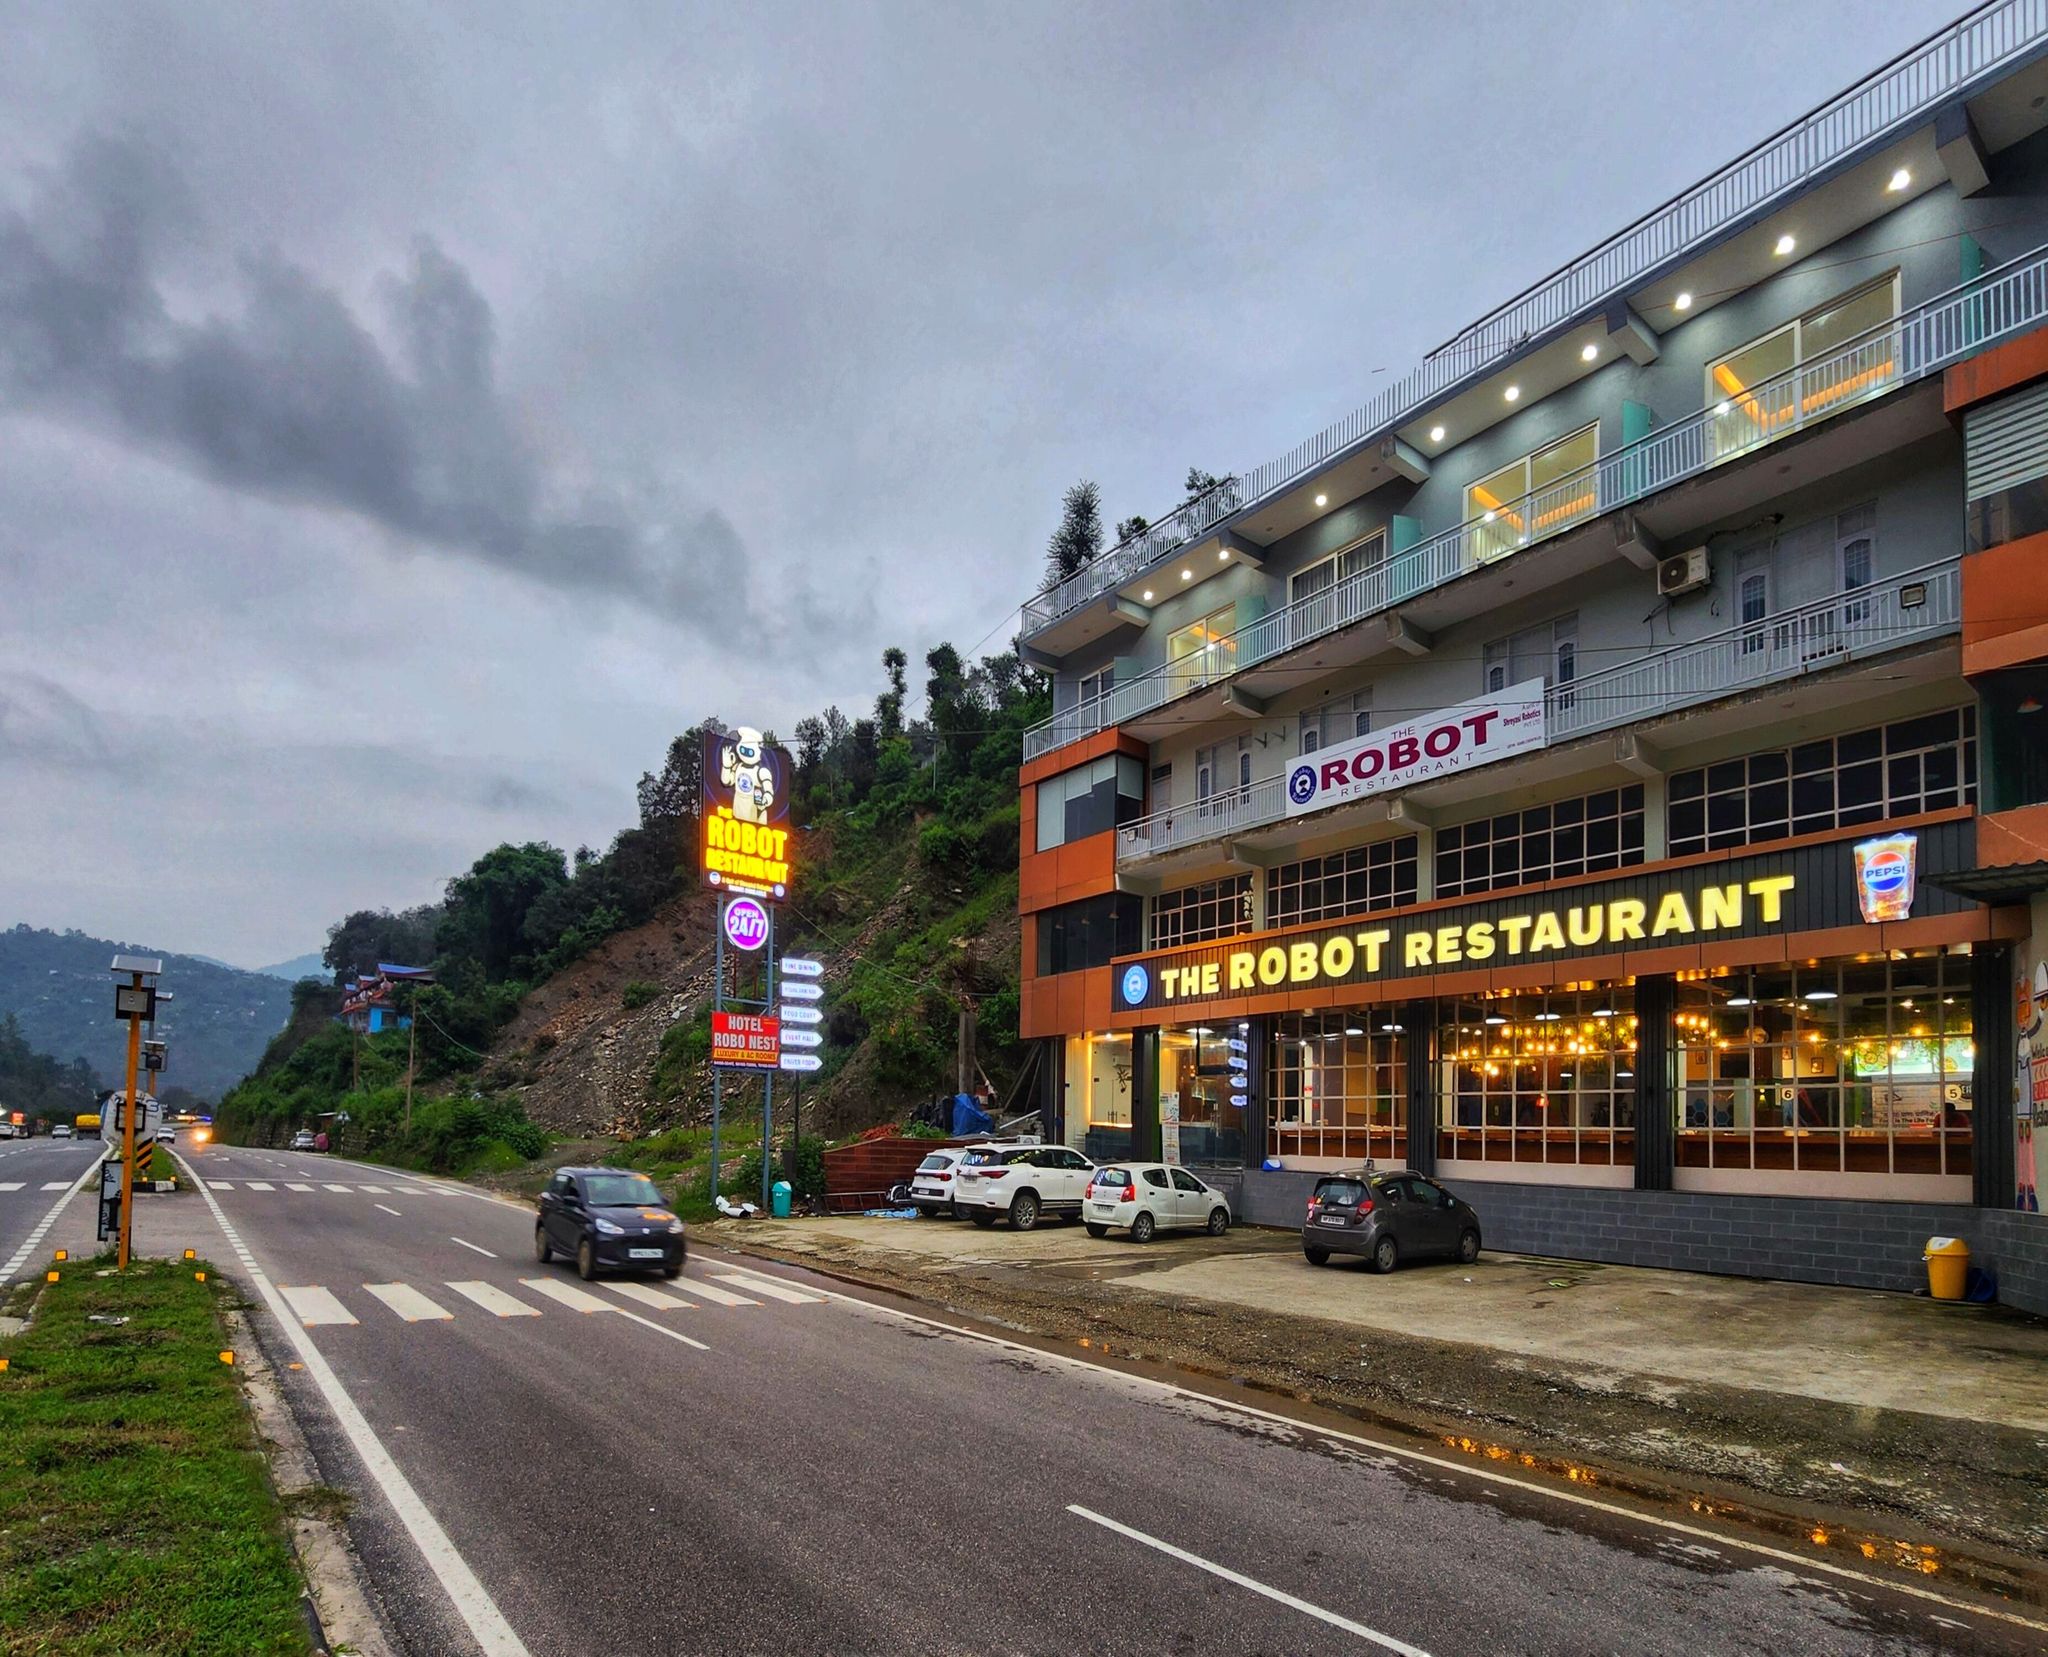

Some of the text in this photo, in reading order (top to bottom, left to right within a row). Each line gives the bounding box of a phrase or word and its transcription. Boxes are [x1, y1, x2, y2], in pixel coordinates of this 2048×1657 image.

[1391, 725, 1416, 740] THE
[1320, 710, 1499, 791] ROBOT
[1340, 751, 1475, 797] RESTAURANT
[707, 814, 788, 861] ROBOT
[705, 847, 789, 884] RESTAURANT
[1866, 866, 1906, 878] PEPSI
[733, 906, 759, 919] OPEN
[730, 915, 765, 938] 24/7
[1160, 875, 1796, 999] THE ROBOT RESTAURANT
[728, 1015, 764, 1032] HOTEL
[714, 1032, 777, 1051] ROBO NEST
[716, 1049, 740, 1058] LUXURY
[746, 1051, 754, 1059] AC
[755, 1051, 776, 1060] ROOMS
[1784, 1089, 1792, 1099] 6
[1949, 1088, 1958, 1099] 5
